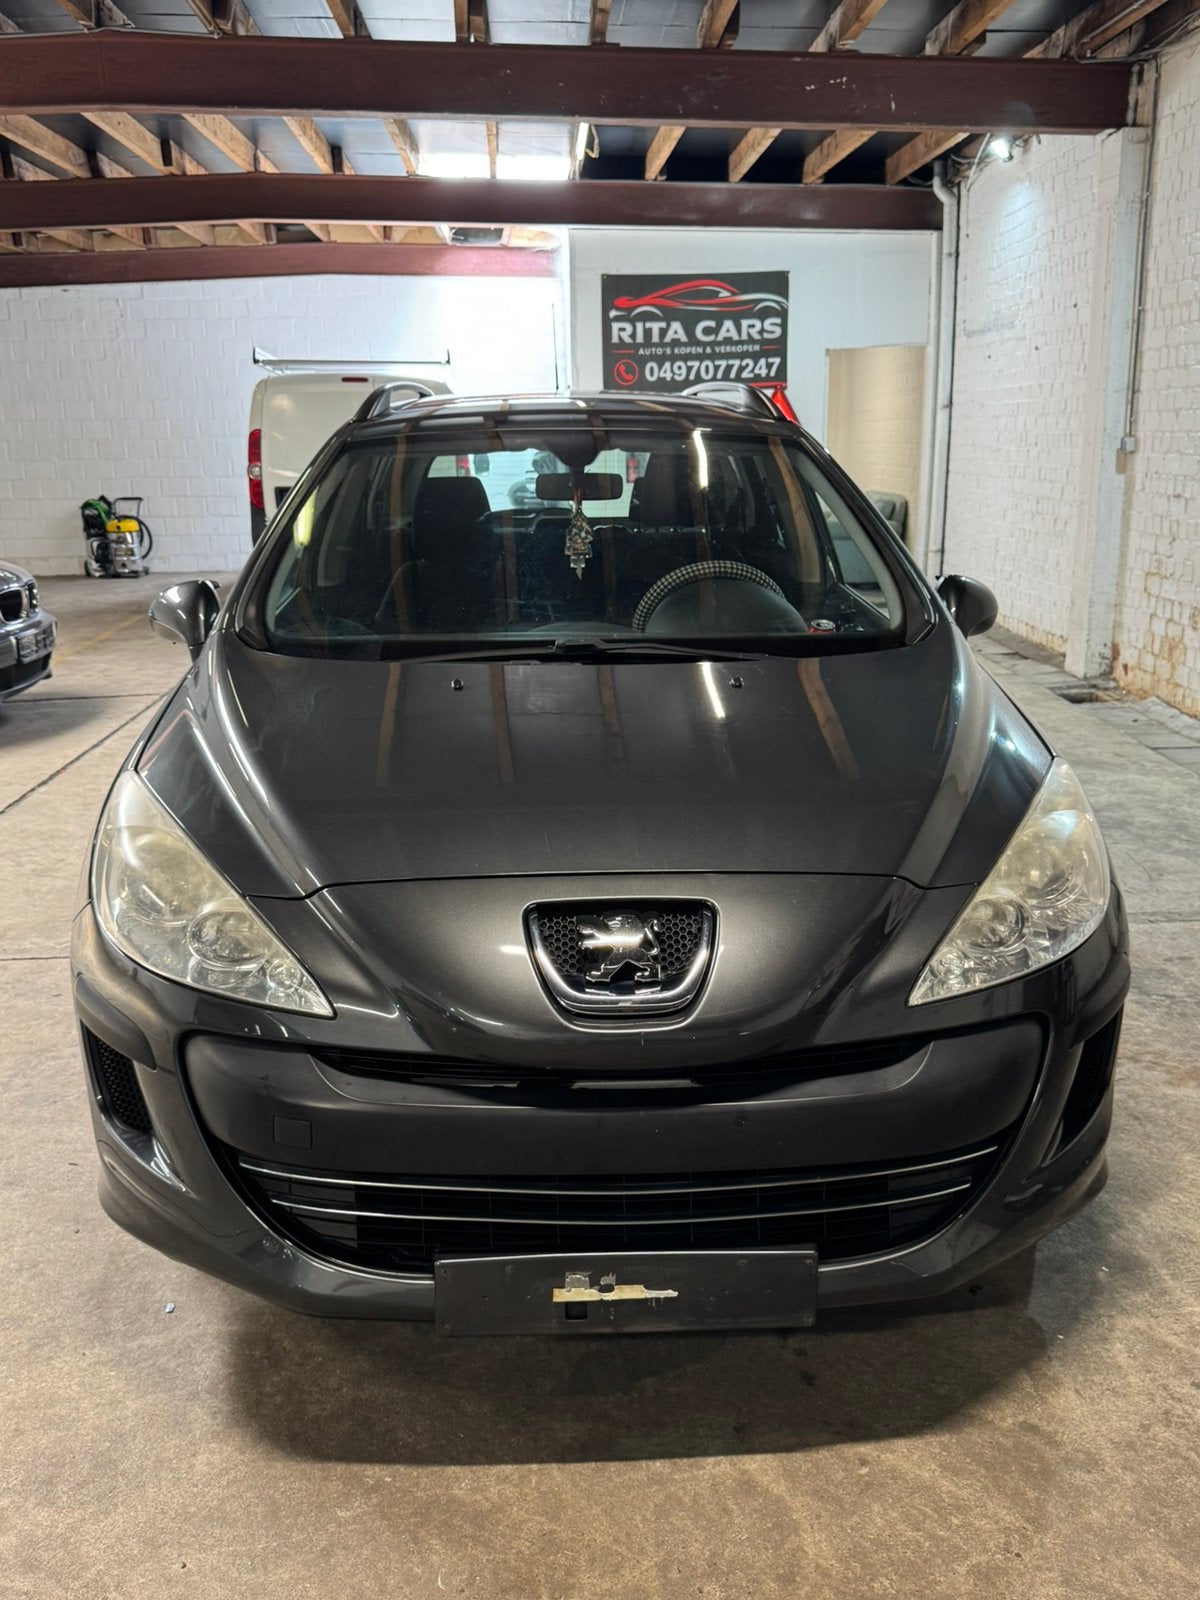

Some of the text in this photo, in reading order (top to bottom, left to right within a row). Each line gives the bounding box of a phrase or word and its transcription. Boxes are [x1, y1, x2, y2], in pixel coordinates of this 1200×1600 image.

[611, 317, 782, 344] RITA CARS
[638, 344, 760, 355] AUTO'S KOPEN & VERKOPEN
[644, 357, 781, 382] 0497077247
